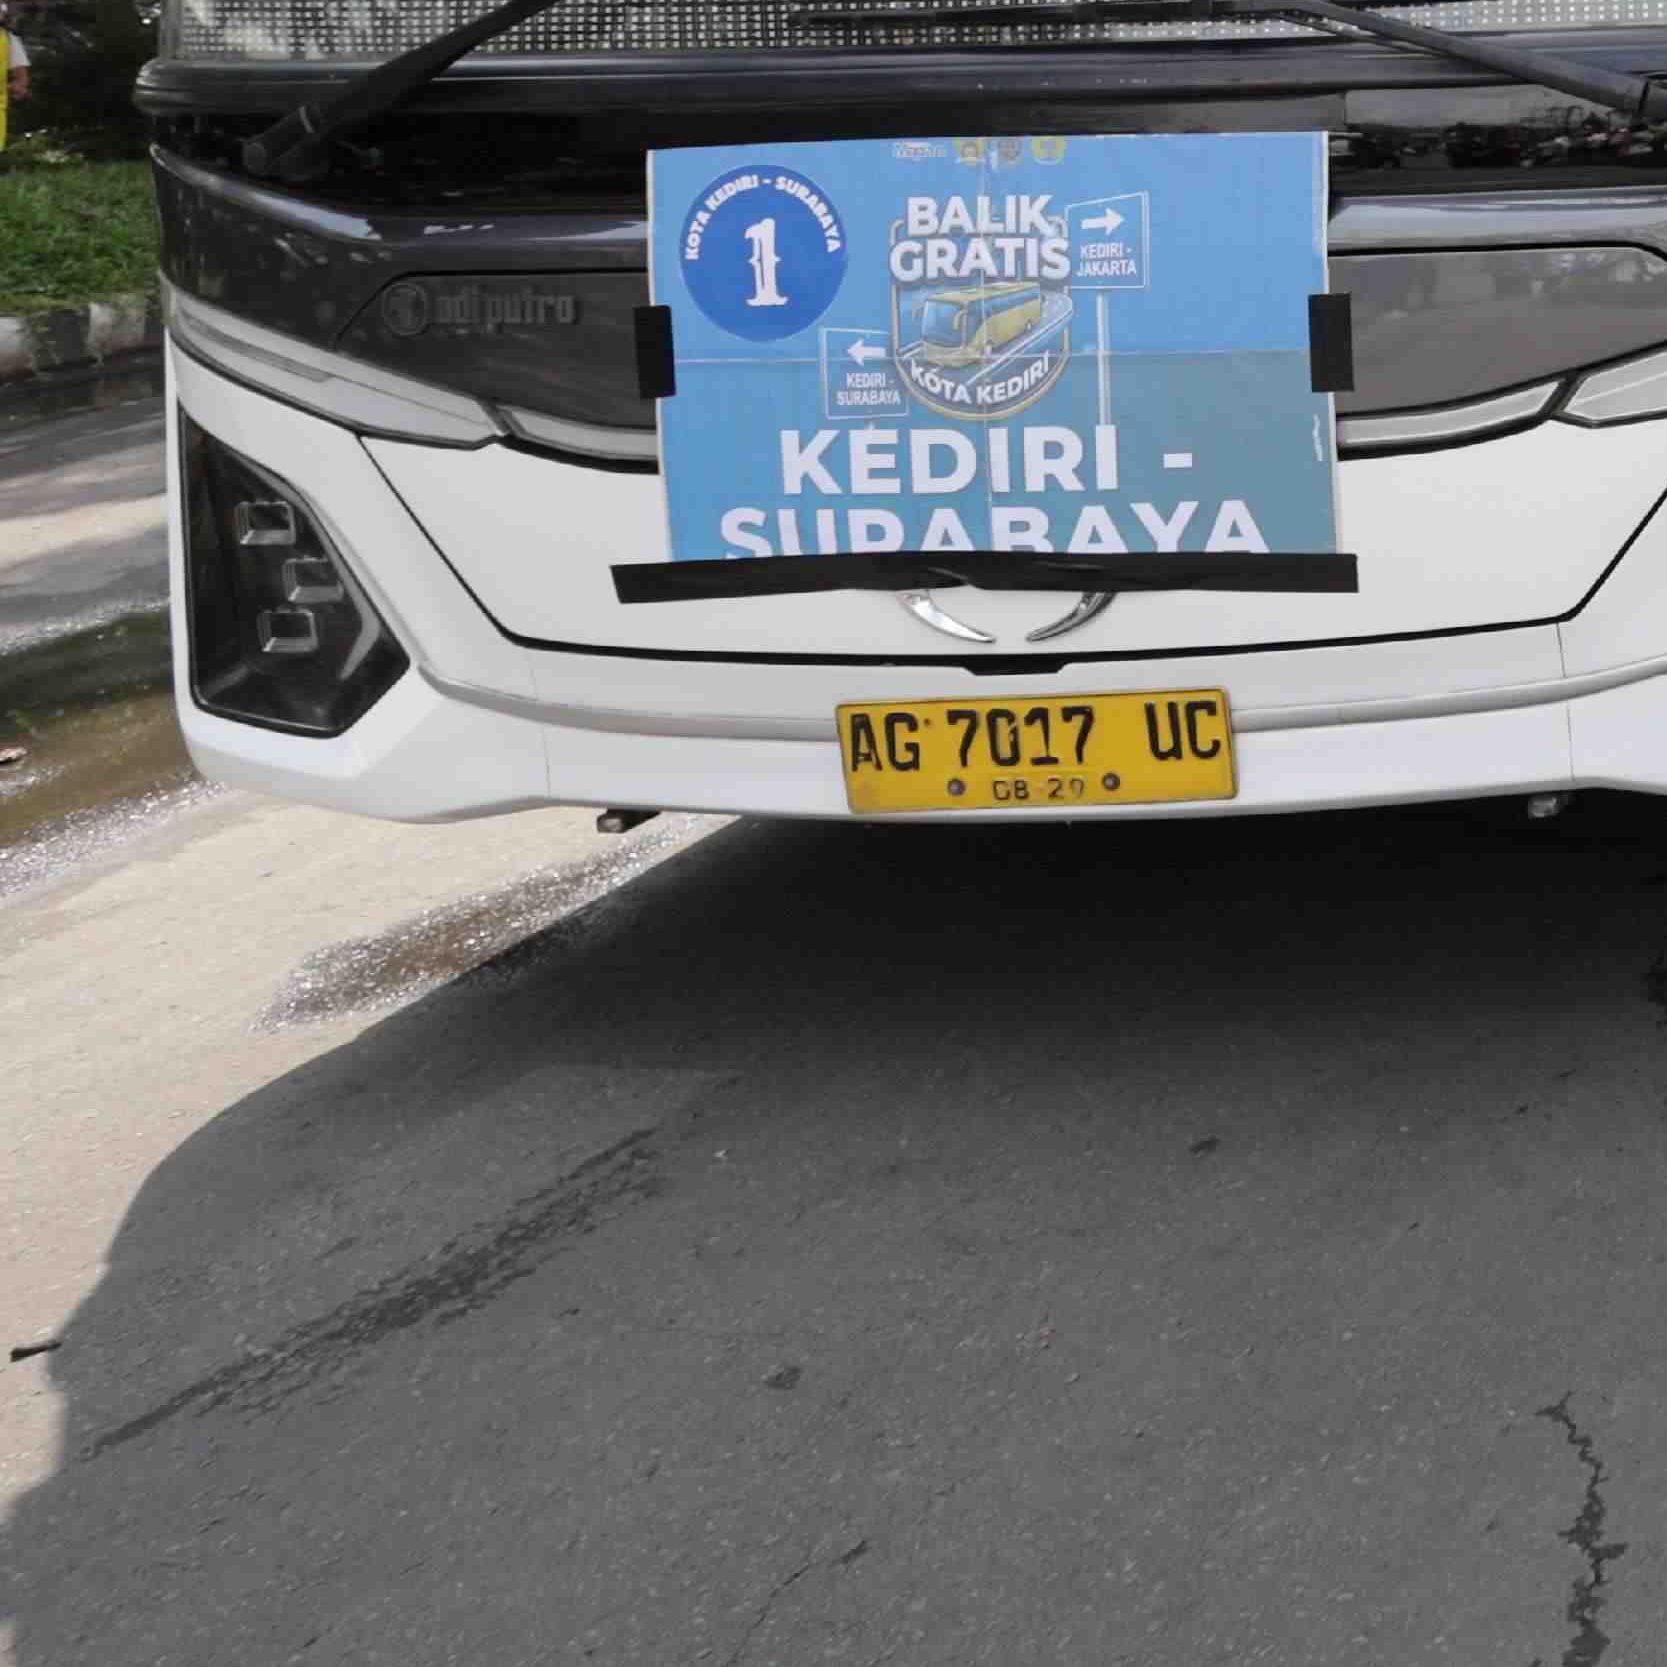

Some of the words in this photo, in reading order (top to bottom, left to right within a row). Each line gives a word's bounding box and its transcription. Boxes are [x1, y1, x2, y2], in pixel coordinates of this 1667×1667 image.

[685, 210, 712, 260] KOTA
[704, 174, 760, 212] KEDIRI
[774, 175, 841, 253] SURABAYA
[907, 194, 1053, 236] BALIK
[744, 217, 789, 307] 1
[889, 236, 1072, 282] GRATIS
[1077, 258, 1137, 278] JAKARTA
[1079, 242, 1124, 259] KEDIRI
[836, 389, 902, 406] SURABAYA
[846, 372, 887, 388] KEDIRI
[911, 358, 972, 405] KOTA
[975, 350, 1050, 405] KEDIRI
[779, 424, 1119, 496] KEDIRI
[851, 712, 921, 773] AG
[946, 706, 1096, 768] 7017
[1144, 700, 1222, 761] UC
